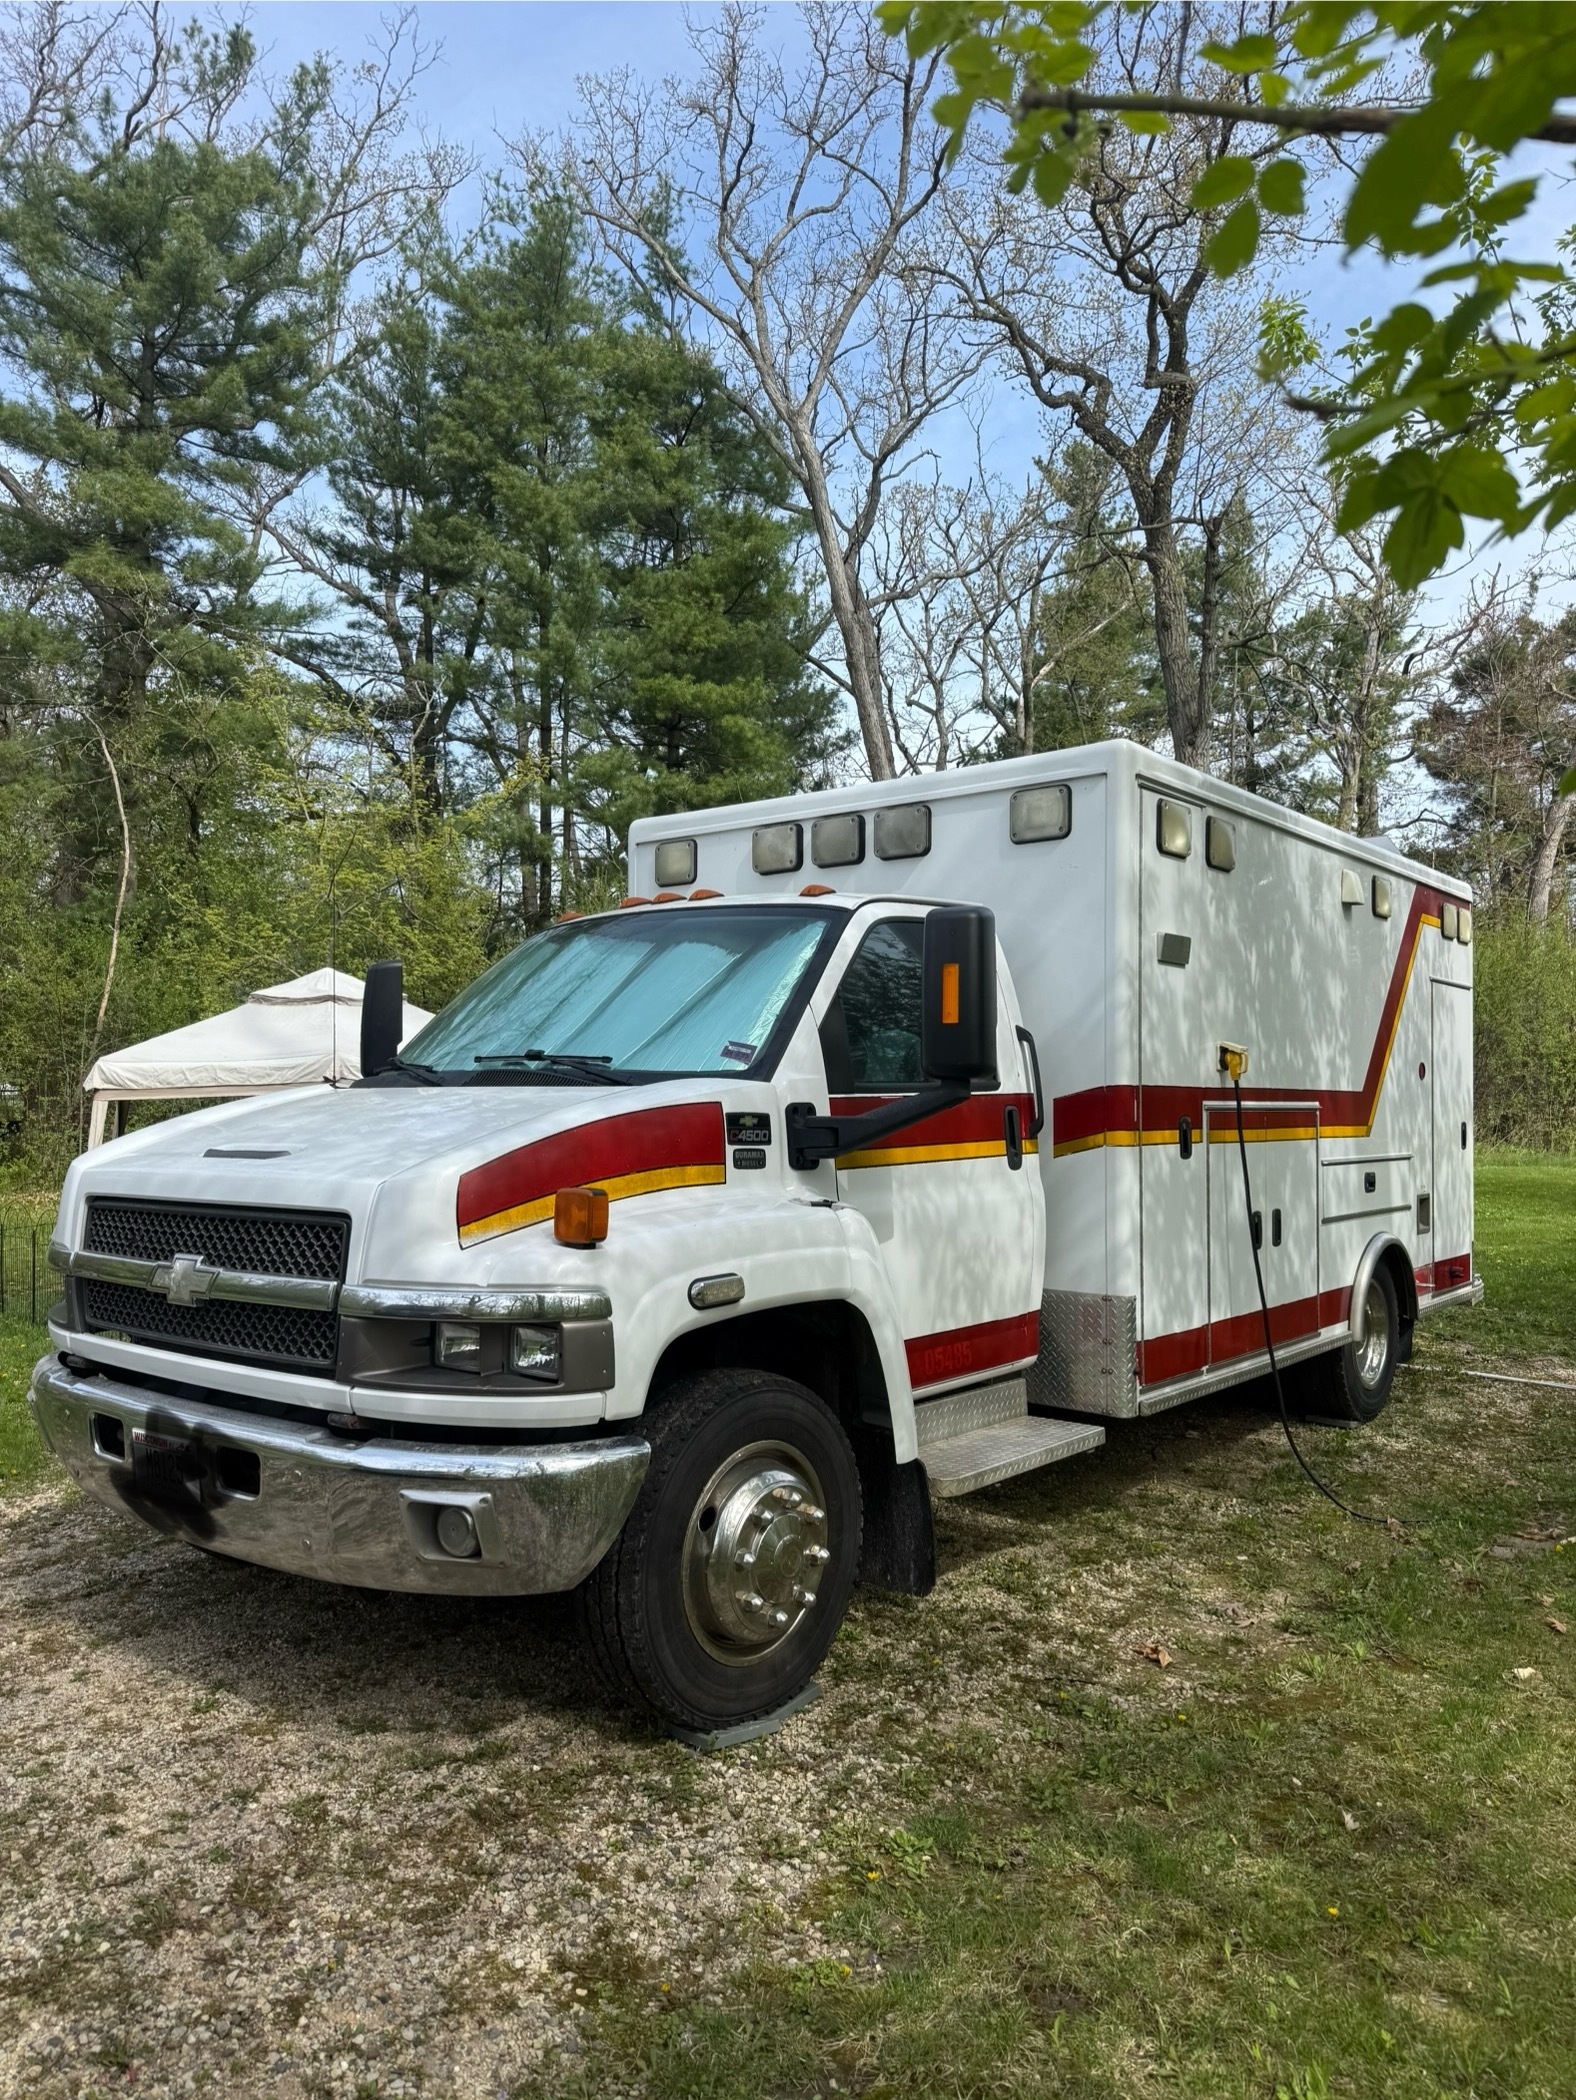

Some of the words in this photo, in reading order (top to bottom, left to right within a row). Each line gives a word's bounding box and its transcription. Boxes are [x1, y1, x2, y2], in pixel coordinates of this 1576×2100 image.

[730, 1129, 769, 1141] C4500
[735, 1151, 765, 1159] DURAMAX
[925, 1341, 972, 1375] 05485
[134, 1431, 168, 1448] WISCONSIN
